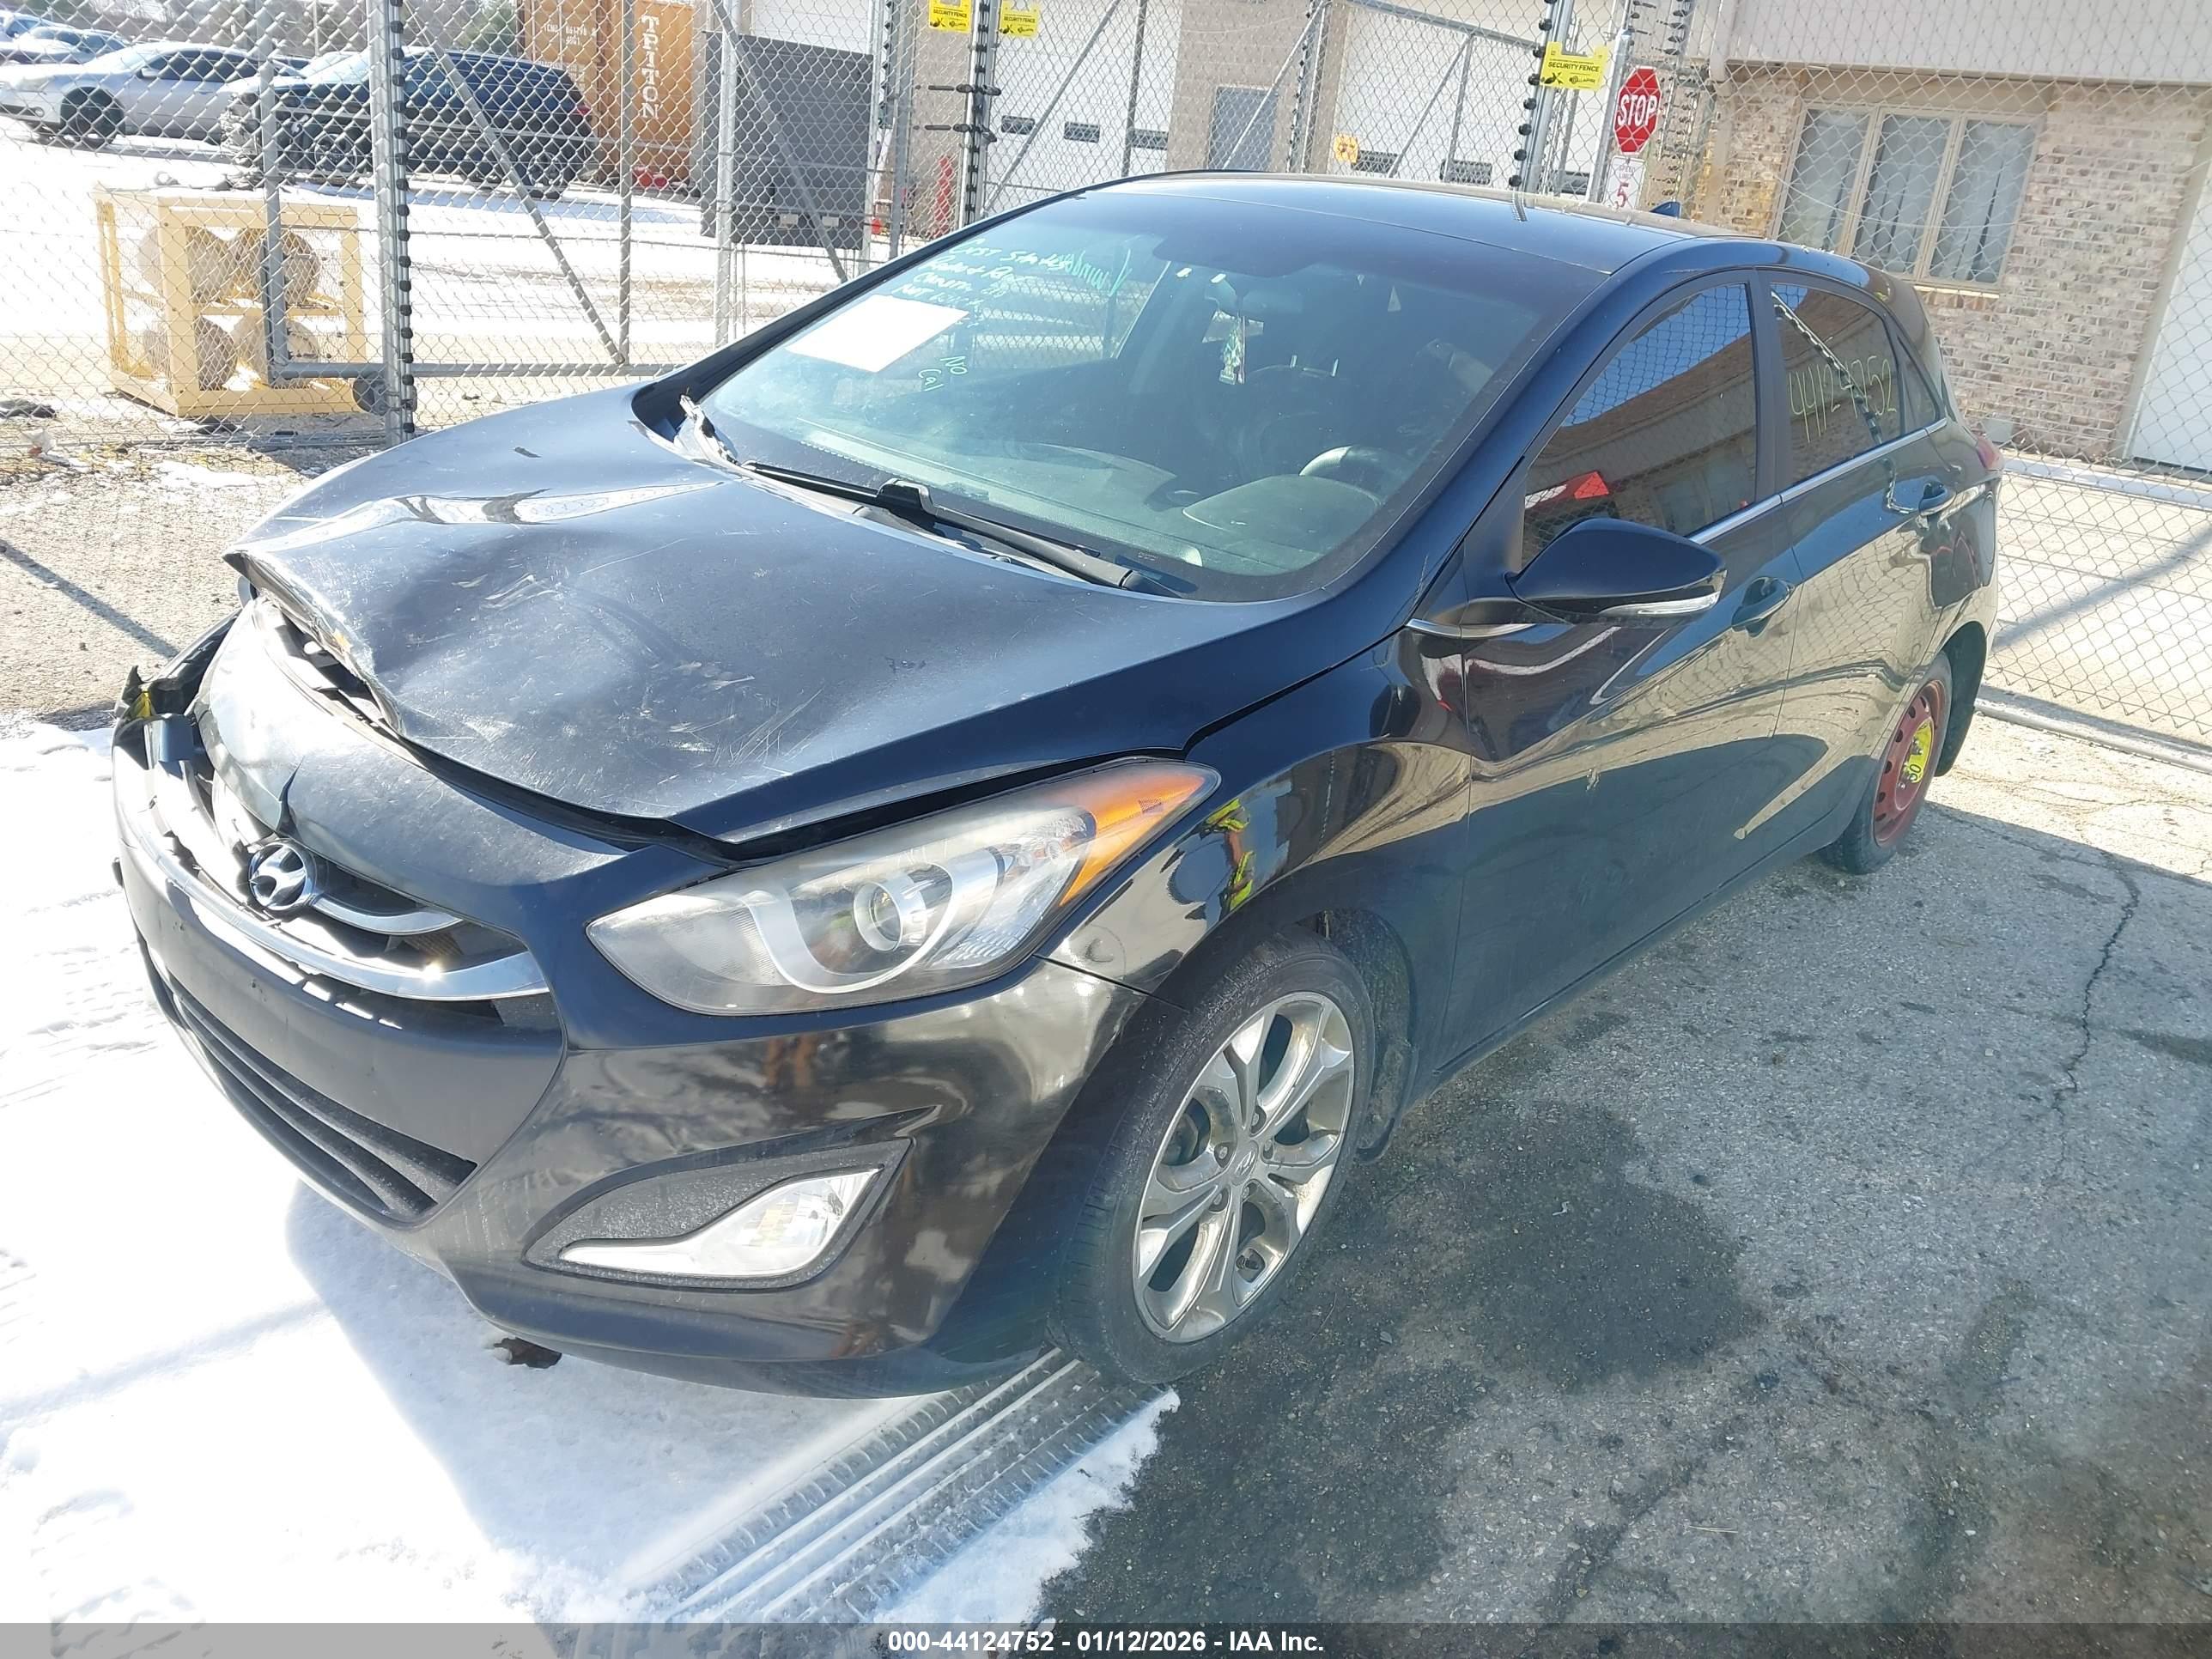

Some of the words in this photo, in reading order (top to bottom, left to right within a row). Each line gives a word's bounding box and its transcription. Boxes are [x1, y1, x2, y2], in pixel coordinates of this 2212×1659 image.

[641, 15, 659, 119] TRITON
[1548, 61, 1579, 70] SECURITY
[1617, 94, 1657, 127] STOP
[1617, 182, 1629, 208] 5
